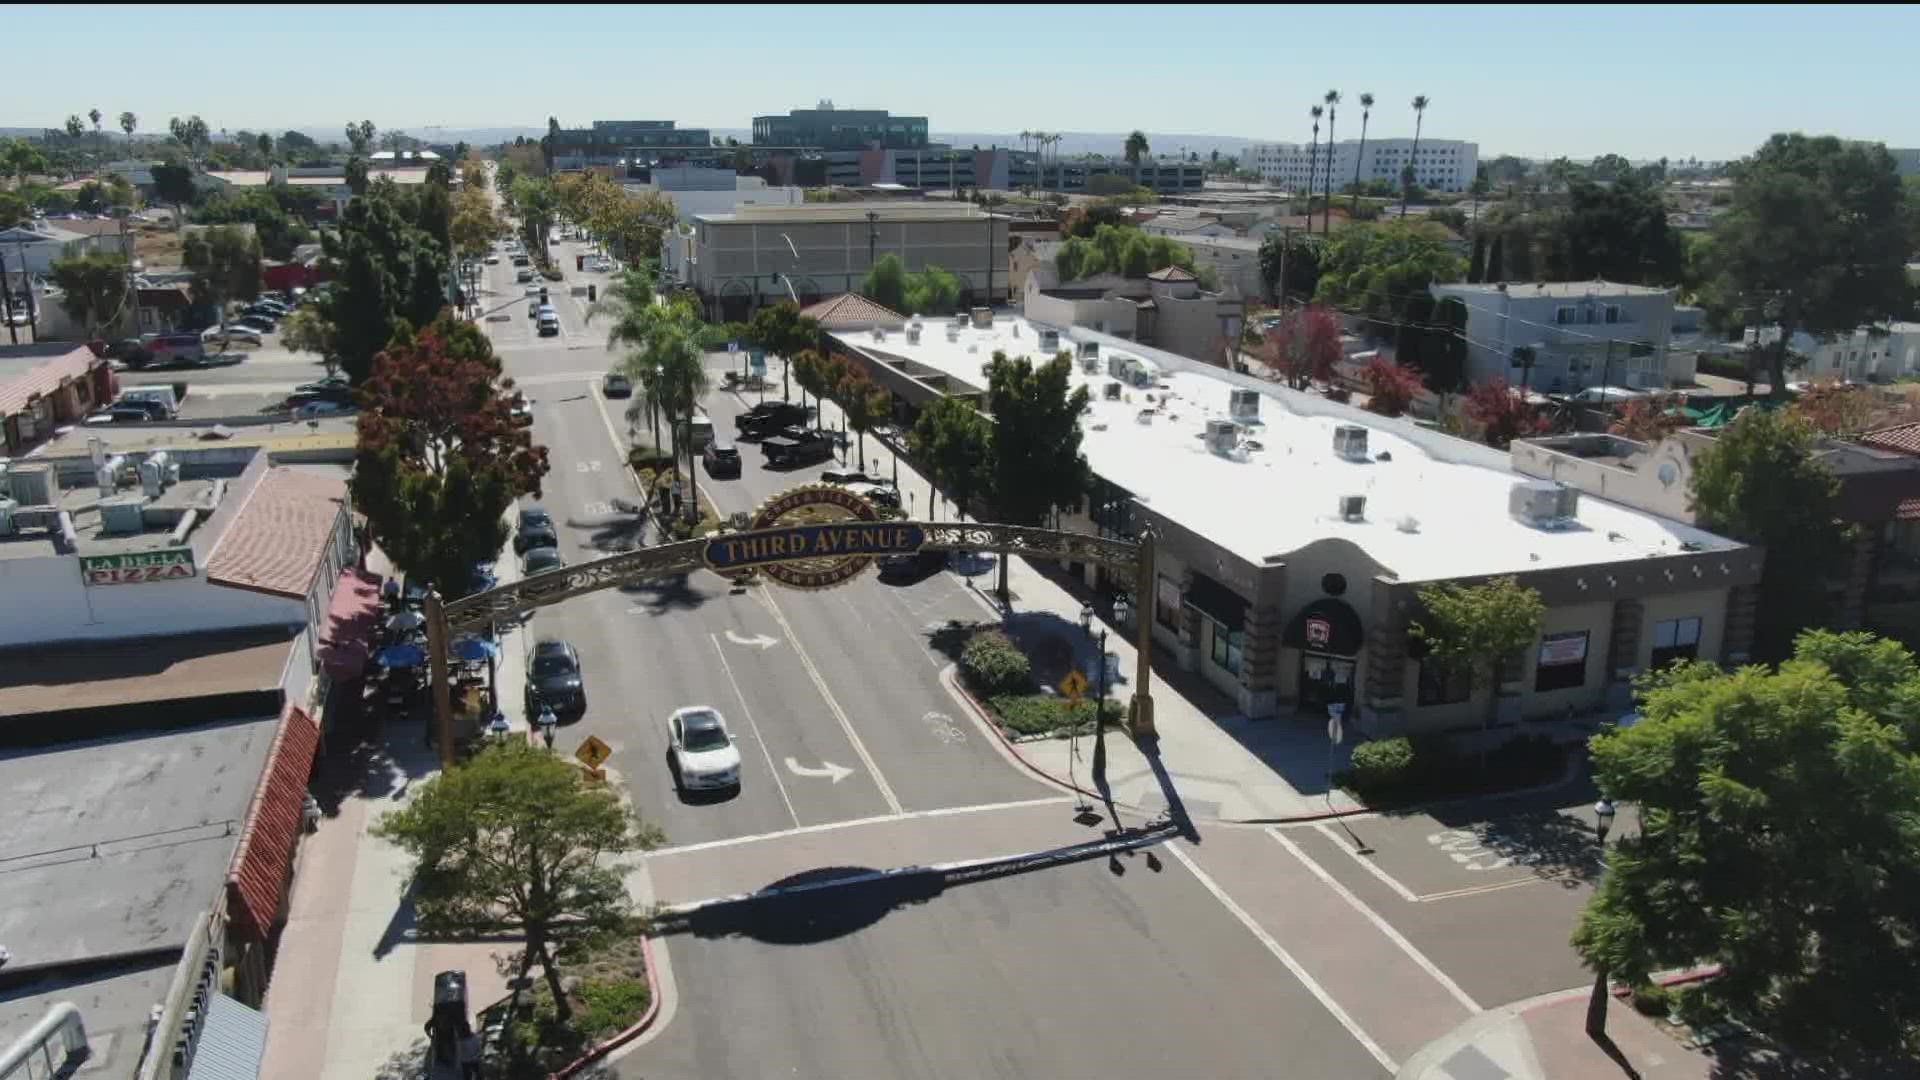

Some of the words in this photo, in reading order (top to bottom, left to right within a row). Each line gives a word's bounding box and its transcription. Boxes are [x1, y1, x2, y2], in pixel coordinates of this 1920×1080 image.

[726, 534, 806, 562] THIRD
[816, 528, 911, 551] AVENUE
[86, 558, 113, 570] LA
[120, 552, 186, 568] BELLA
[88, 566, 189, 583] PIZZA
